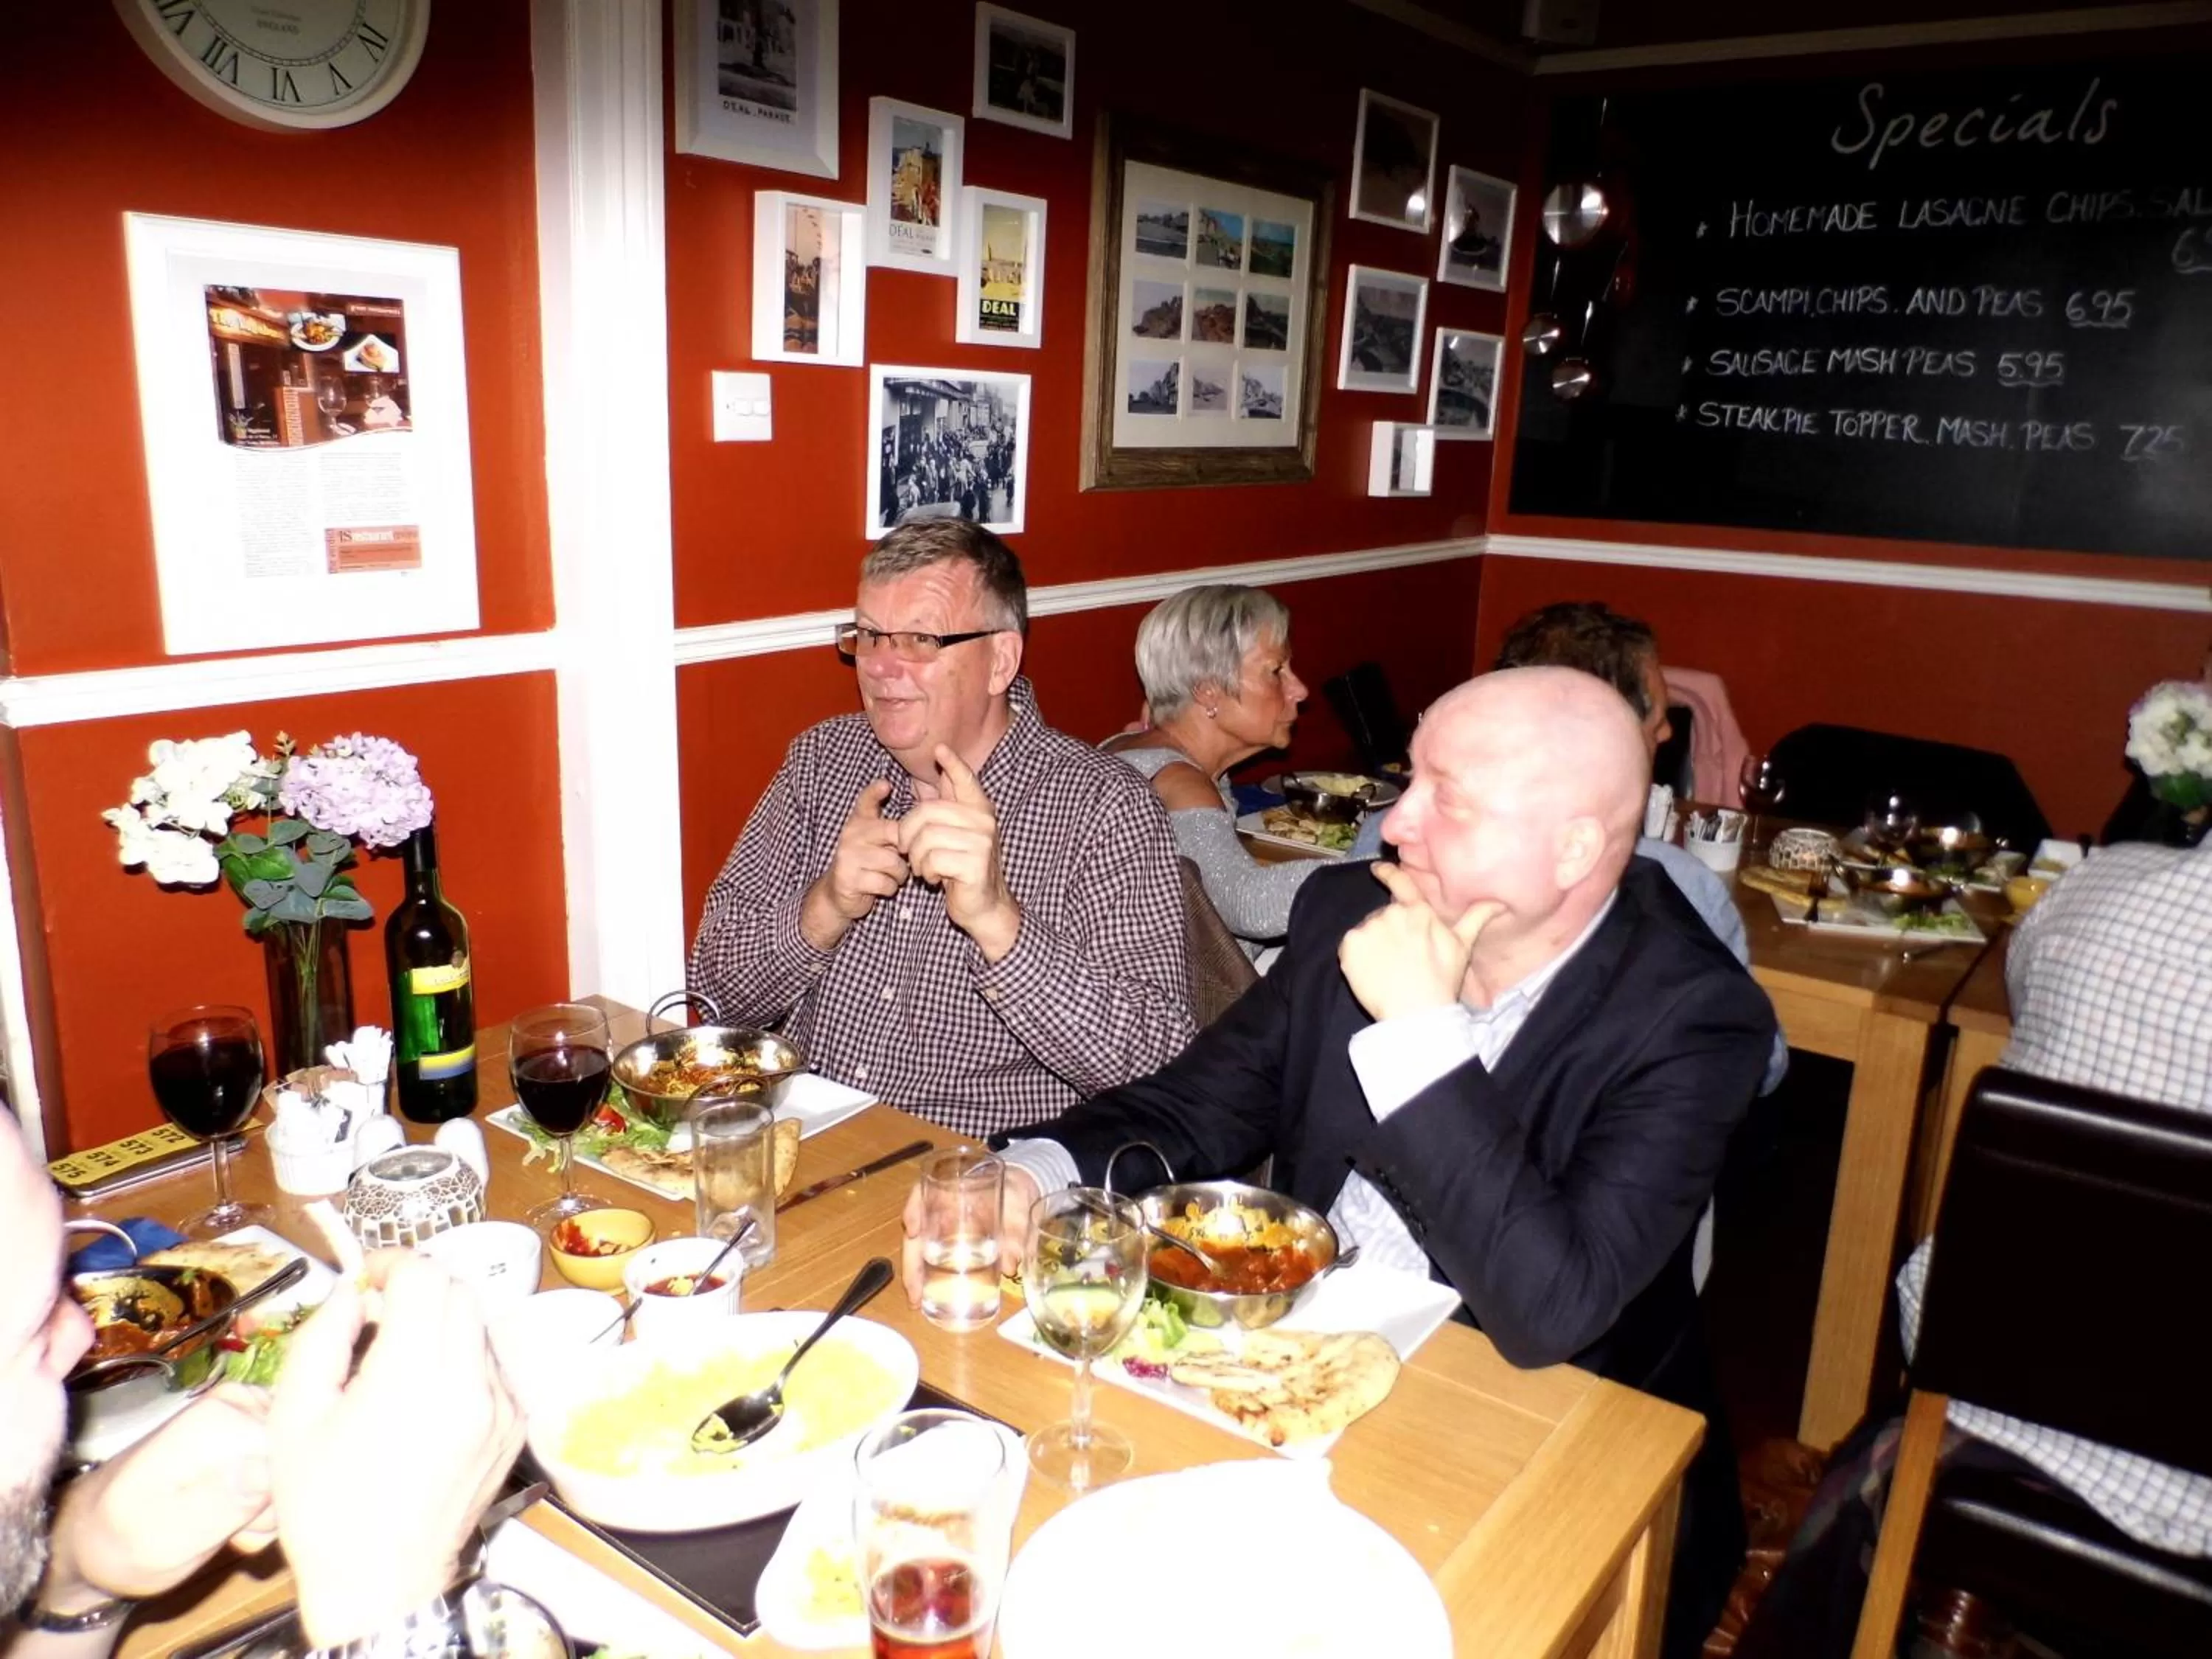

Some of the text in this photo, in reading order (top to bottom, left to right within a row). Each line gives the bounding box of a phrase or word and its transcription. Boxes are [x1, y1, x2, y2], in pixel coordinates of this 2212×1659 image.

[1830, 76, 2118, 170] Specials
[1729, 198, 1878, 238] HOMEMADE
[1898, 194, 2028, 230] LASAGNE
[981, 300, 1017, 316] DEAL
[1905, 286, 1966, 316] AND
[1972, 284, 2045, 318] PEAS
[1705, 348, 1818, 378] SAUSAGE
[1826, 346, 1900, 376] MASH
[1902, 348, 1978, 378] PEAS
[2020, 419, 2096, 451] PEAS
[120, 1138, 153, 1155] 573
[153, 1128, 186, 1144] 572
[52, 1162, 87, 1179] 575
[86, 1150, 120, 1167] 574
